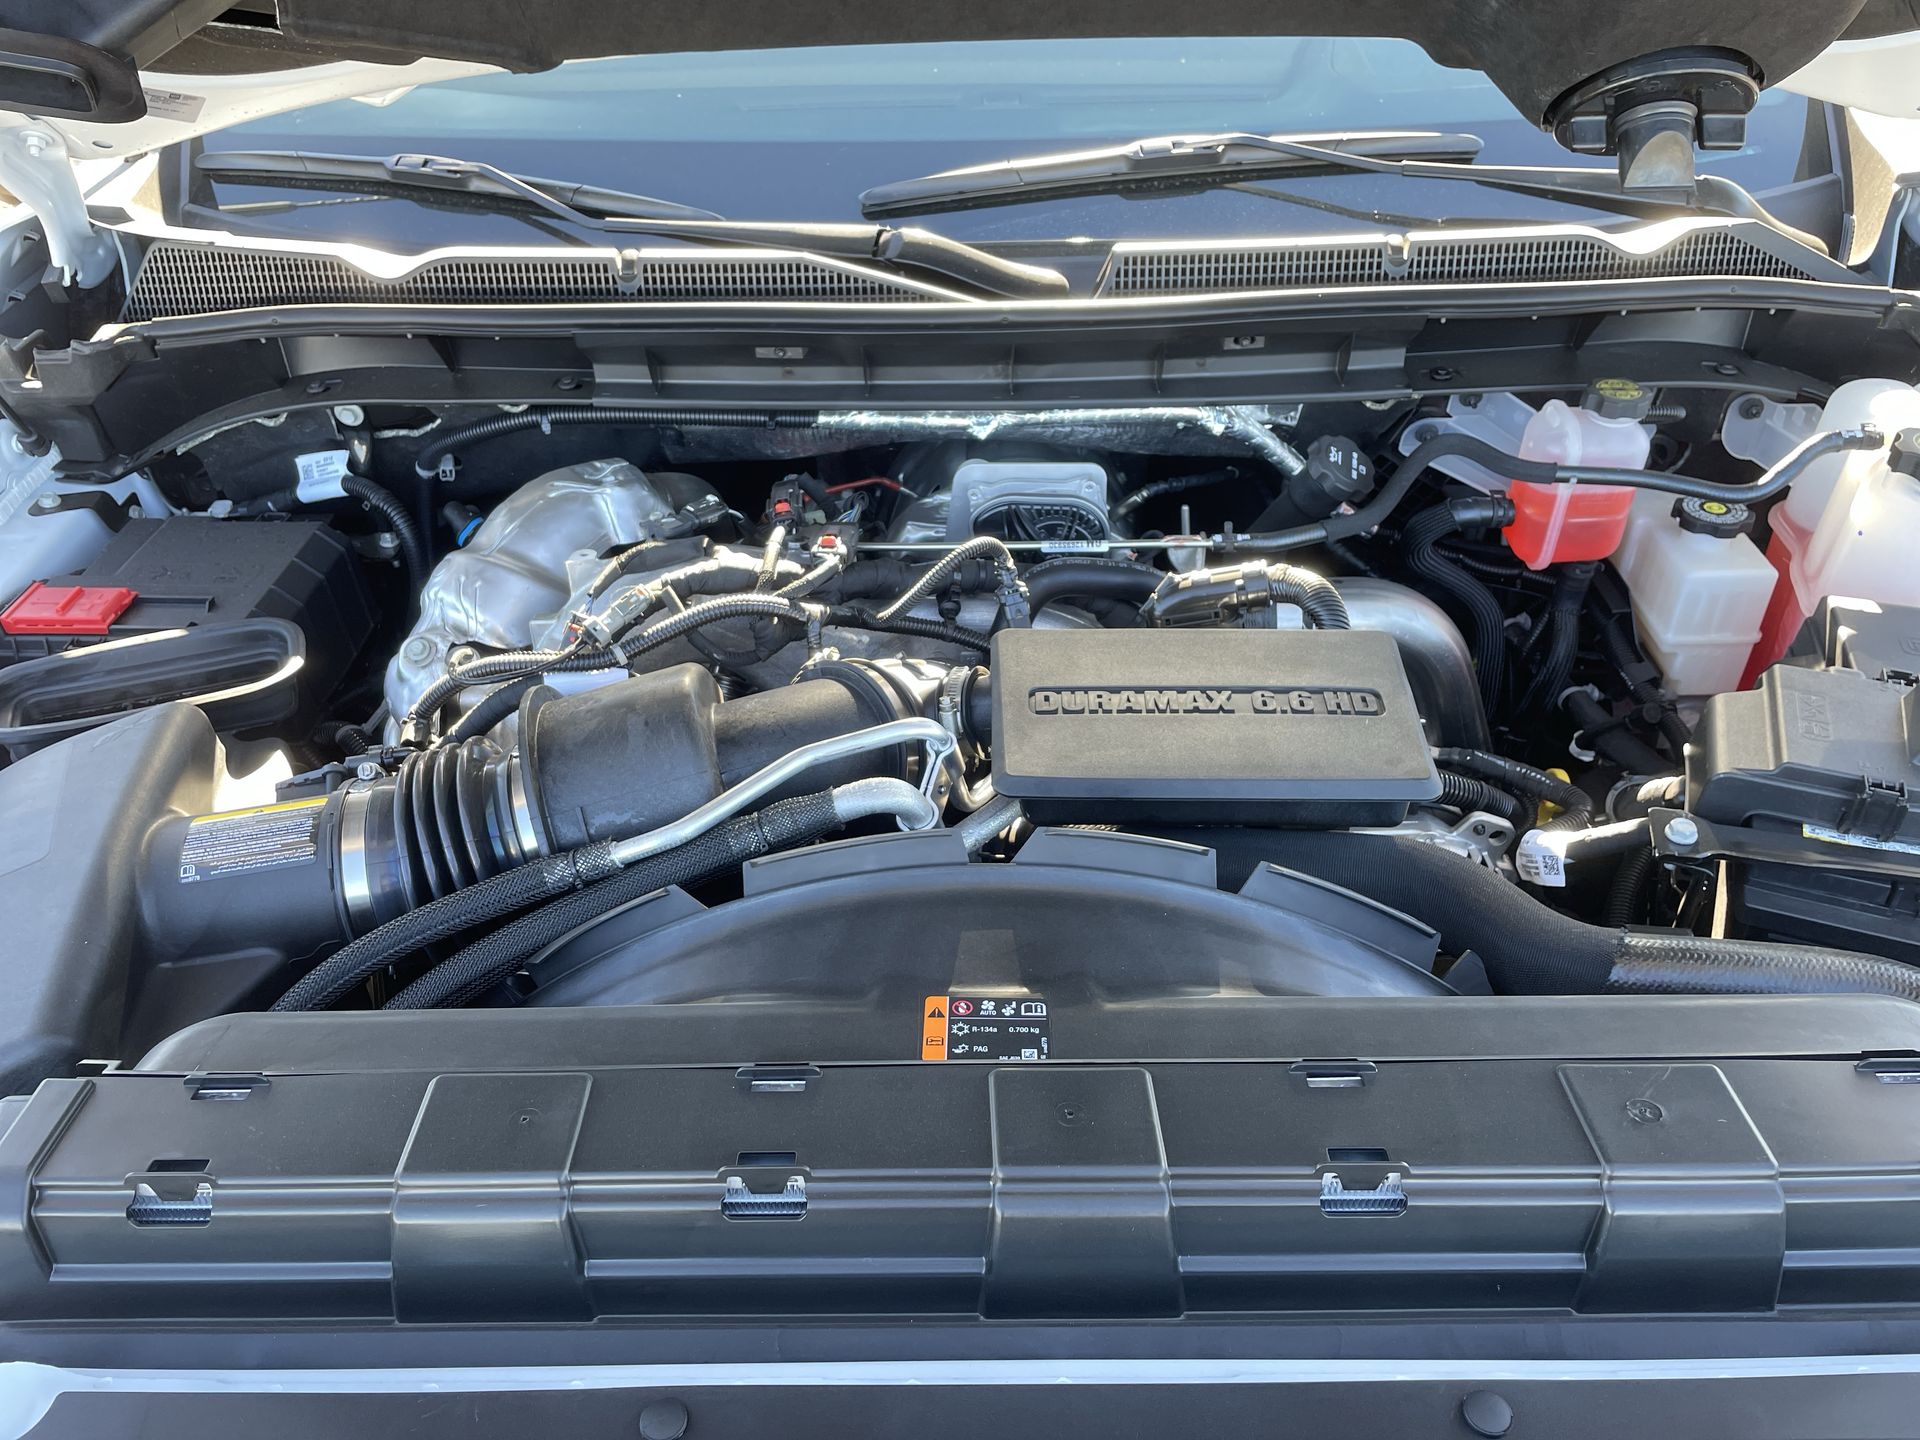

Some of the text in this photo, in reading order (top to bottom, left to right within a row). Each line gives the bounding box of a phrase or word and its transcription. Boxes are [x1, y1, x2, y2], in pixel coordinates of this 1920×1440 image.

[1034, 689, 1380, 715] DURAMAX 6.6 HD
